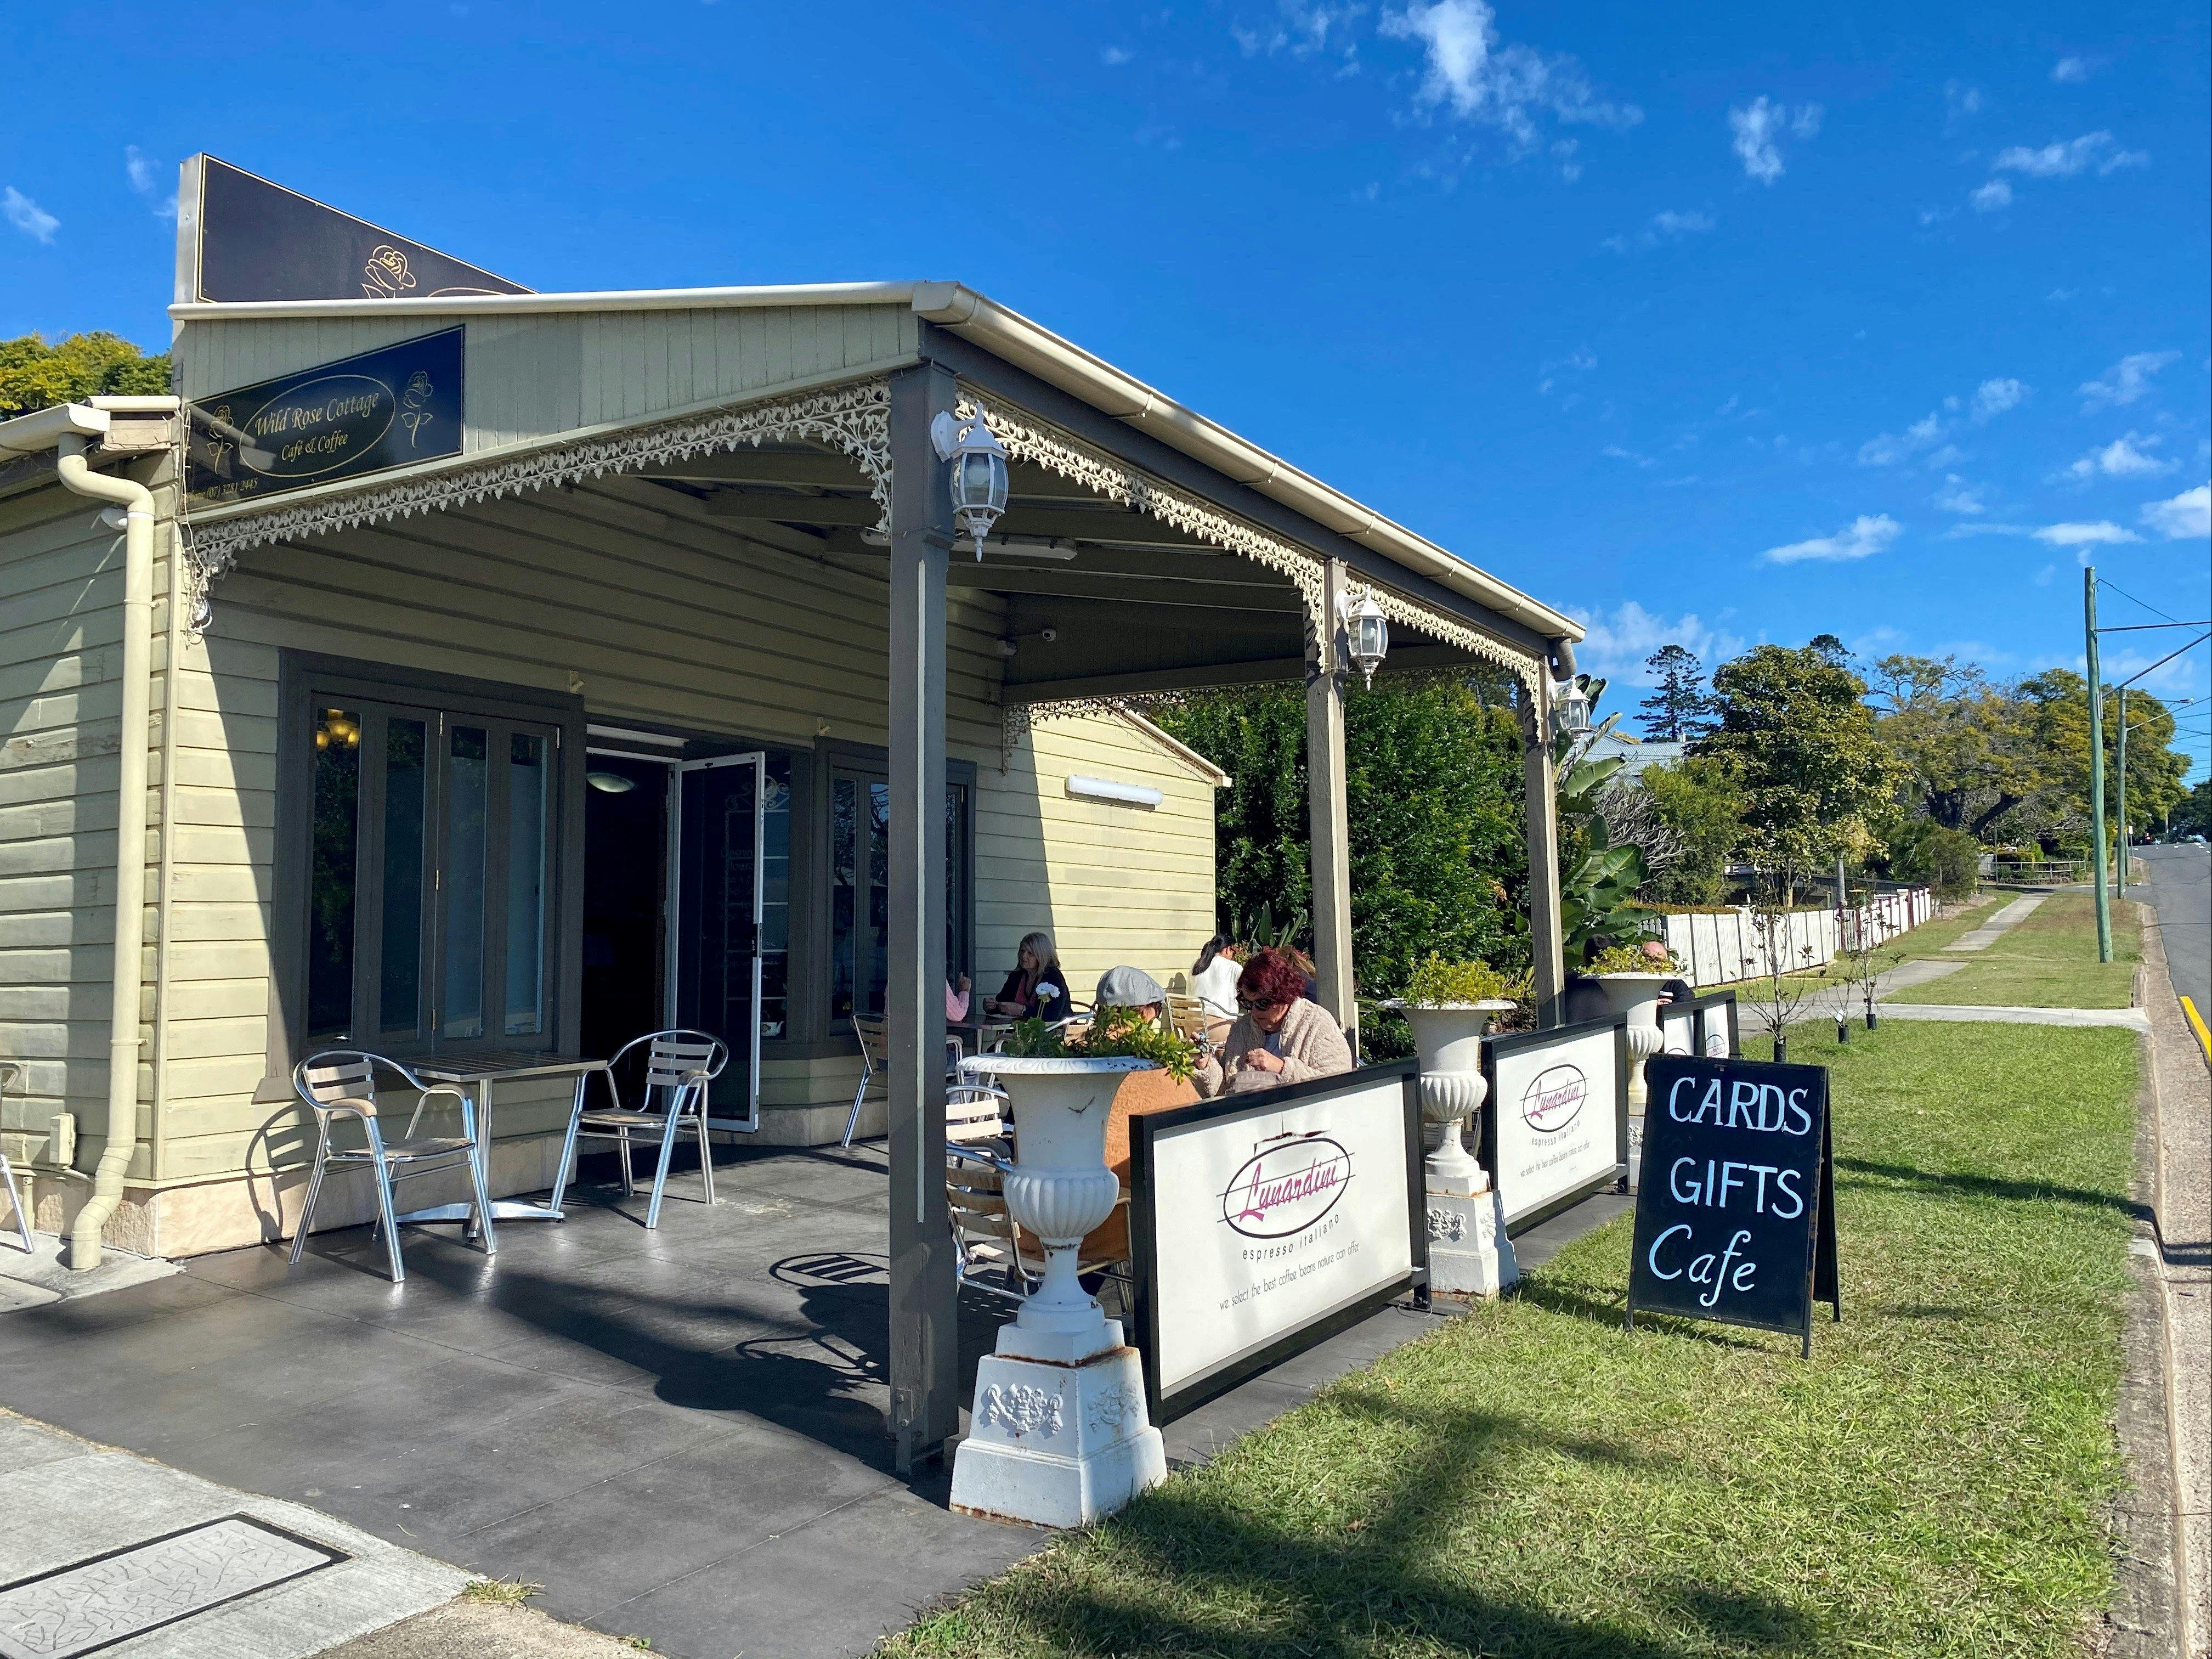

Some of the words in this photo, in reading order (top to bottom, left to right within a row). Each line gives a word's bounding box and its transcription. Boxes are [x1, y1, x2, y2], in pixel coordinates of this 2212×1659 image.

[255, 407, 291, 437] Wild
[291, 407, 323, 430] Rose
[326, 392, 380, 421] Cottage
[305, 436, 316, 454] &
[318, 430, 348, 454] Coffee
[1530, 1078, 1580, 1120] Lunardini
[1669, 1076, 1811, 1136] CARDS
[1531, 1137, 1557, 1148] espresso
[1559, 1120, 1580, 1141] italiano
[1239, 1155, 1339, 1223] Lunardini
[1670, 1156, 1803, 1220] GIFTS
[1243, 1244, 1293, 1263] espresso
[1299, 1214, 1339, 1248] italiano
[1649, 1223, 1756, 1307] Cafe
[1219, 1298, 1229, 1311] we
[1231, 1289, 1249, 1306] select
[1252, 1283, 1261, 1297] the
[1263, 1278, 1276, 1292] best
[1278, 1268, 1297, 1286] coffee
[1299, 1264, 1316, 1277] beans
[1317, 1253, 1334, 1269] nature
[1336, 1248, 1346, 1261] can
[1348, 1240, 1360, 1255] offer
